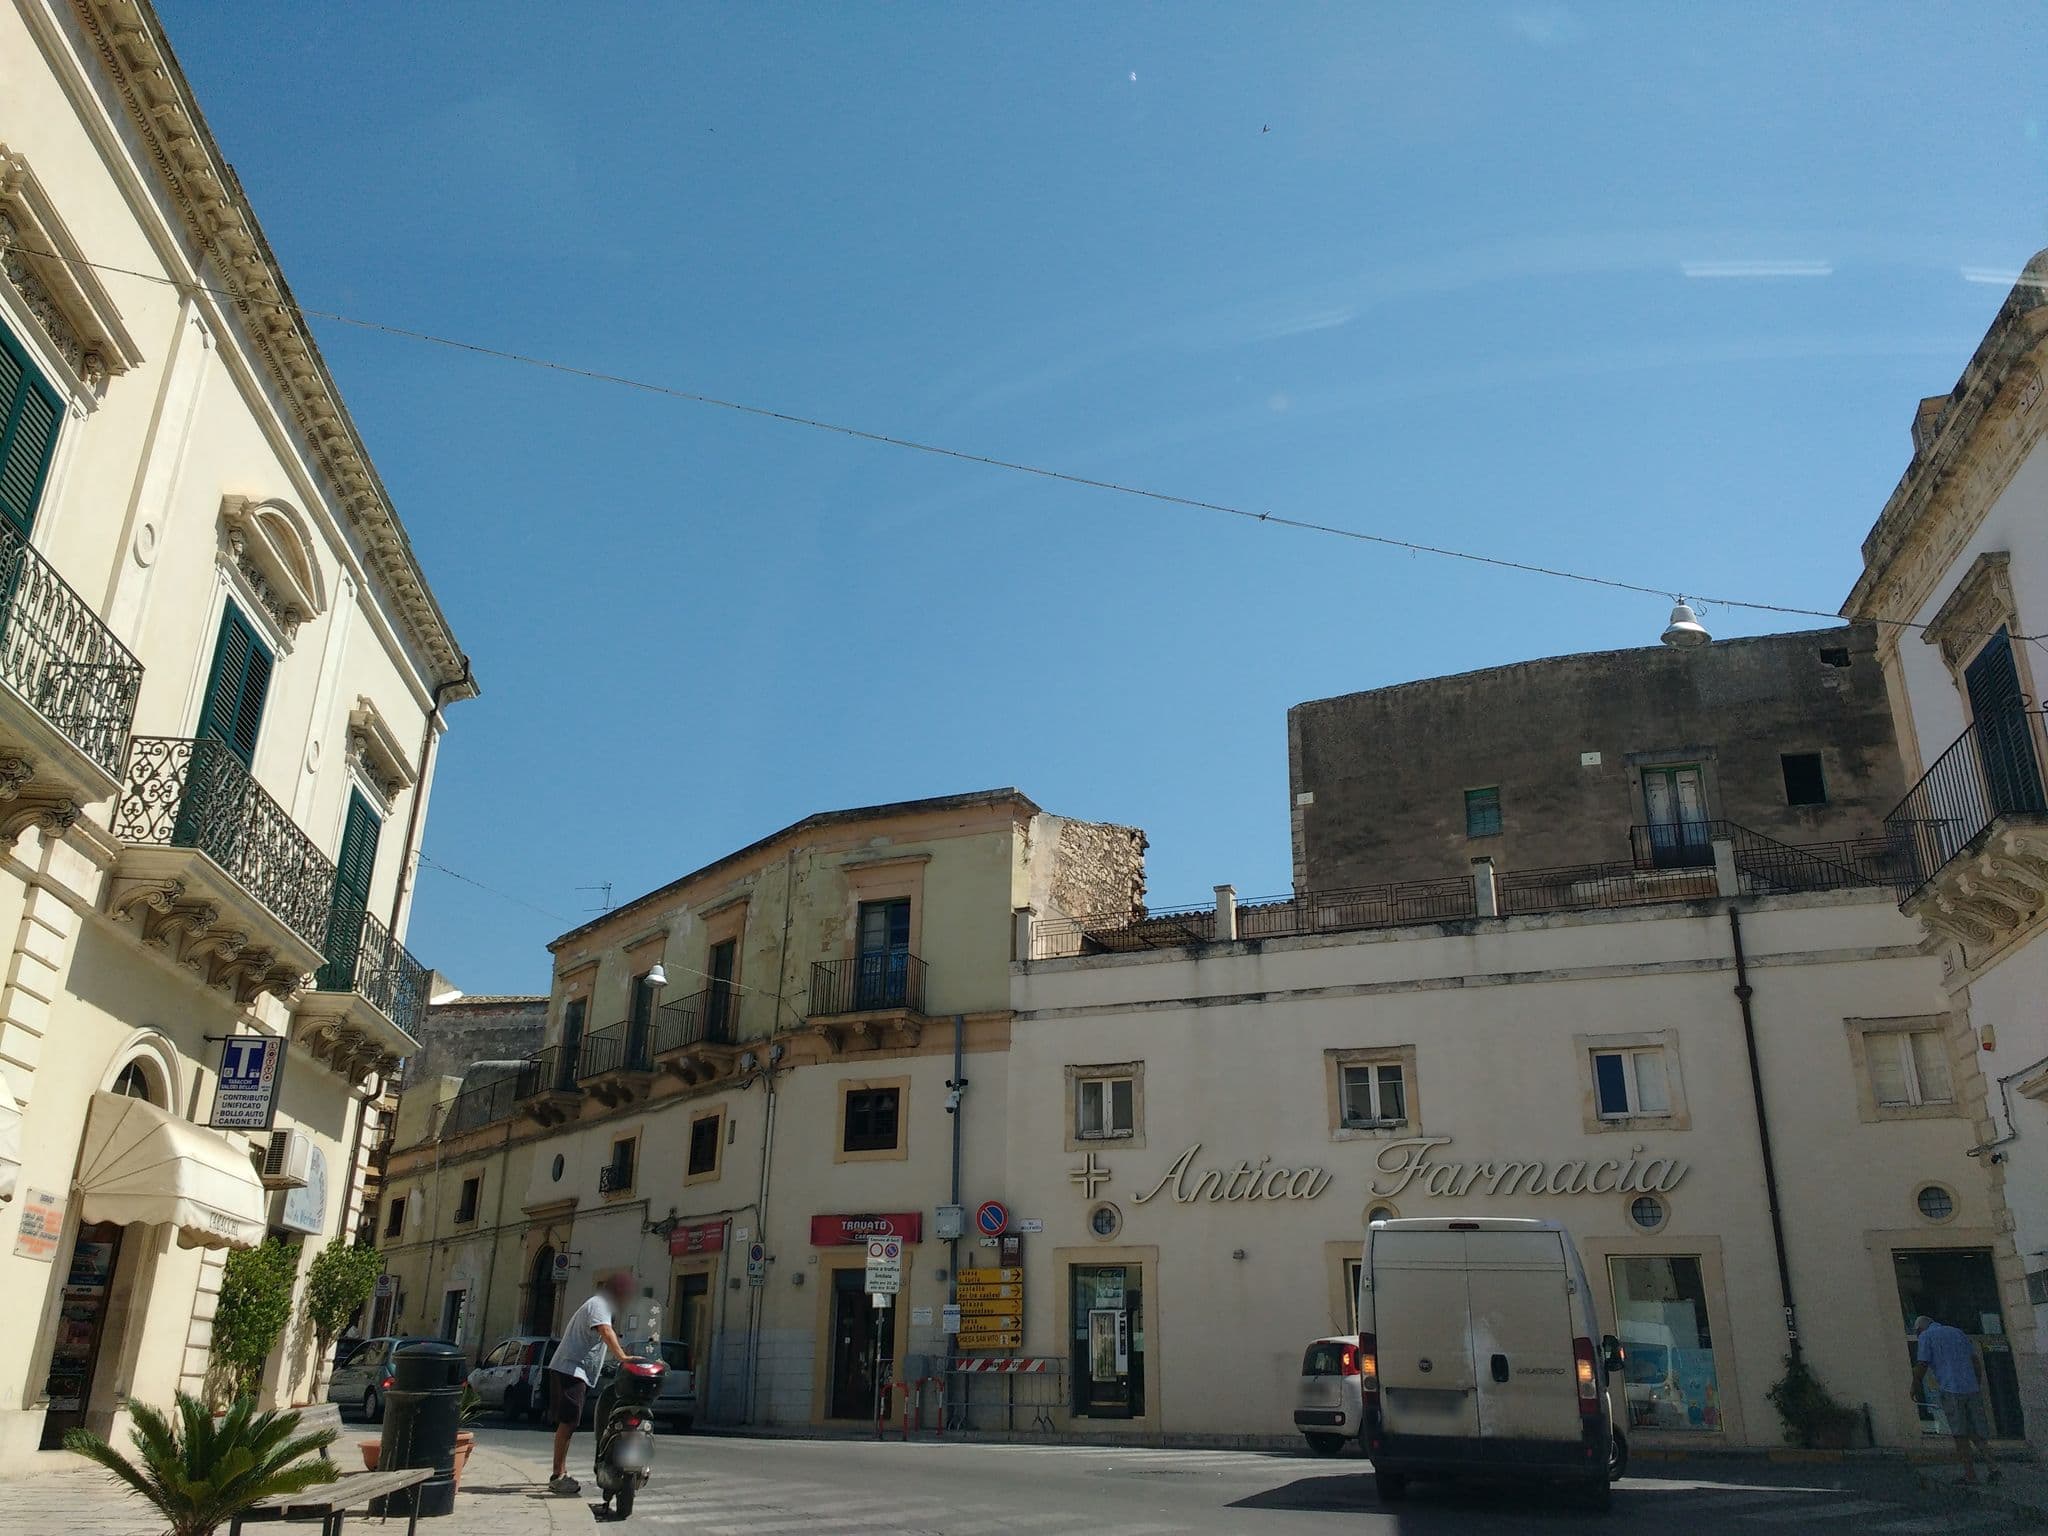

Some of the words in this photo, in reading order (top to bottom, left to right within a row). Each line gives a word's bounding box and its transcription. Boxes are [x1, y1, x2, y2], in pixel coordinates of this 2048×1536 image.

[231, 1040, 263, 1078] T
[222, 1094, 269, 1102] CONTRIBUTO
[244, 1110, 265, 1118] AUTO
[253, 1118, 263, 1126] TV
[1130, 1143, 1333, 1204] Antica
[1368, 1137, 1692, 1198] Farmacia
[209, 1212, 240, 1236] TABACCHI
[841, 1221, 887, 1231] TROVATO
